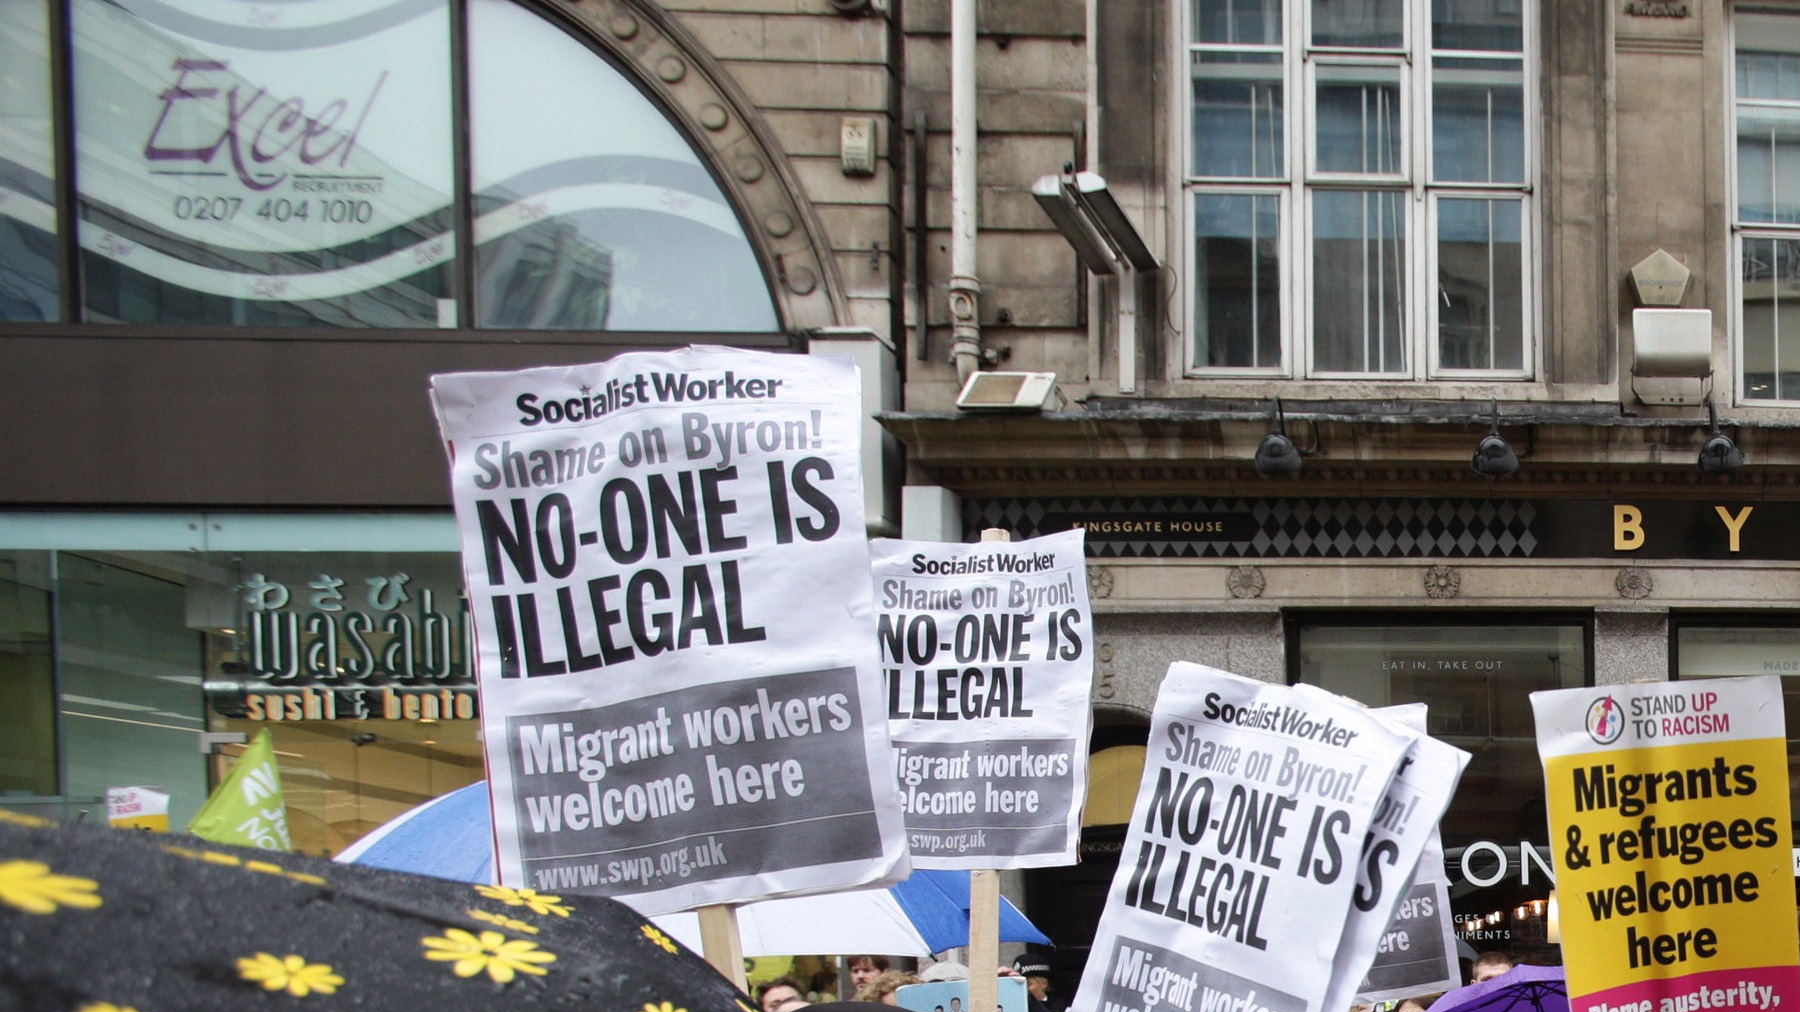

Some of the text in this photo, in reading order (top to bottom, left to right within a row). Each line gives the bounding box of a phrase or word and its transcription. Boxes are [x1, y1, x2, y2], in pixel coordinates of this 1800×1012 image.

[143, 58, 389, 191] Excel
[174, 196, 373, 223] 0207 404 1010
[293, 181, 384, 192] RECRUITMENT
[517, 372, 782, 426] Socialist Worker
[473, 410, 822, 491] Shame on Byron!
[475, 457, 840, 586] NO-ONE IS
[1170, 521, 1223, 533] HOUSE
[912, 552, 1055, 575] Socialist Worker
[247, 572, 410, 612] わさび
[883, 573, 1075, 615] Shame on Byron!
[249, 589, 472, 680] wasabi
[491, 561, 766, 679] ILLEGAL
[878, 608, 1082, 665] NO-ONE IS
[1382, 661, 1404, 670] EAT
[1437, 661, 1468, 670] TAKE
[1475, 661, 1503, 670] OUT
[1763, 661, 1799, 671] MADE
[247, 689, 473, 720] sushi & bento
[1203, 692, 1358, 748] Socialist Worker
[1631, 693, 1718, 717] STAND UP
[1633, 714, 1730, 739] TO RACISM
[521, 688, 852, 780] Migrant workers
[893, 744, 1068, 786] igrant workers
[1166, 722, 1367, 804] Shame on Byron!
[1573, 757, 1757, 816] Migrants
[528, 747, 805, 833] welcome here
[899, 781, 1039, 814] elcome here
[906, 830, 986, 852] .swp.org.uk
[1145, 768, 1297, 870] NO-ONE
[1298, 805, 1351, 884] IS
[1565, 816, 1778, 870] & refugees
[537, 840, 727, 893] www.swp.org.uk
[1125, 841, 1270, 950] ILLEGAL
[1455, 914, 1479, 923] GES
[1587, 870, 1759, 922] welcome
[1378, 929, 1410, 953] ere
[1455, 930, 1511, 940] NIMENTS
[1627, 926, 1718, 969] here
[1113, 946, 1197, 1012] Migrant
